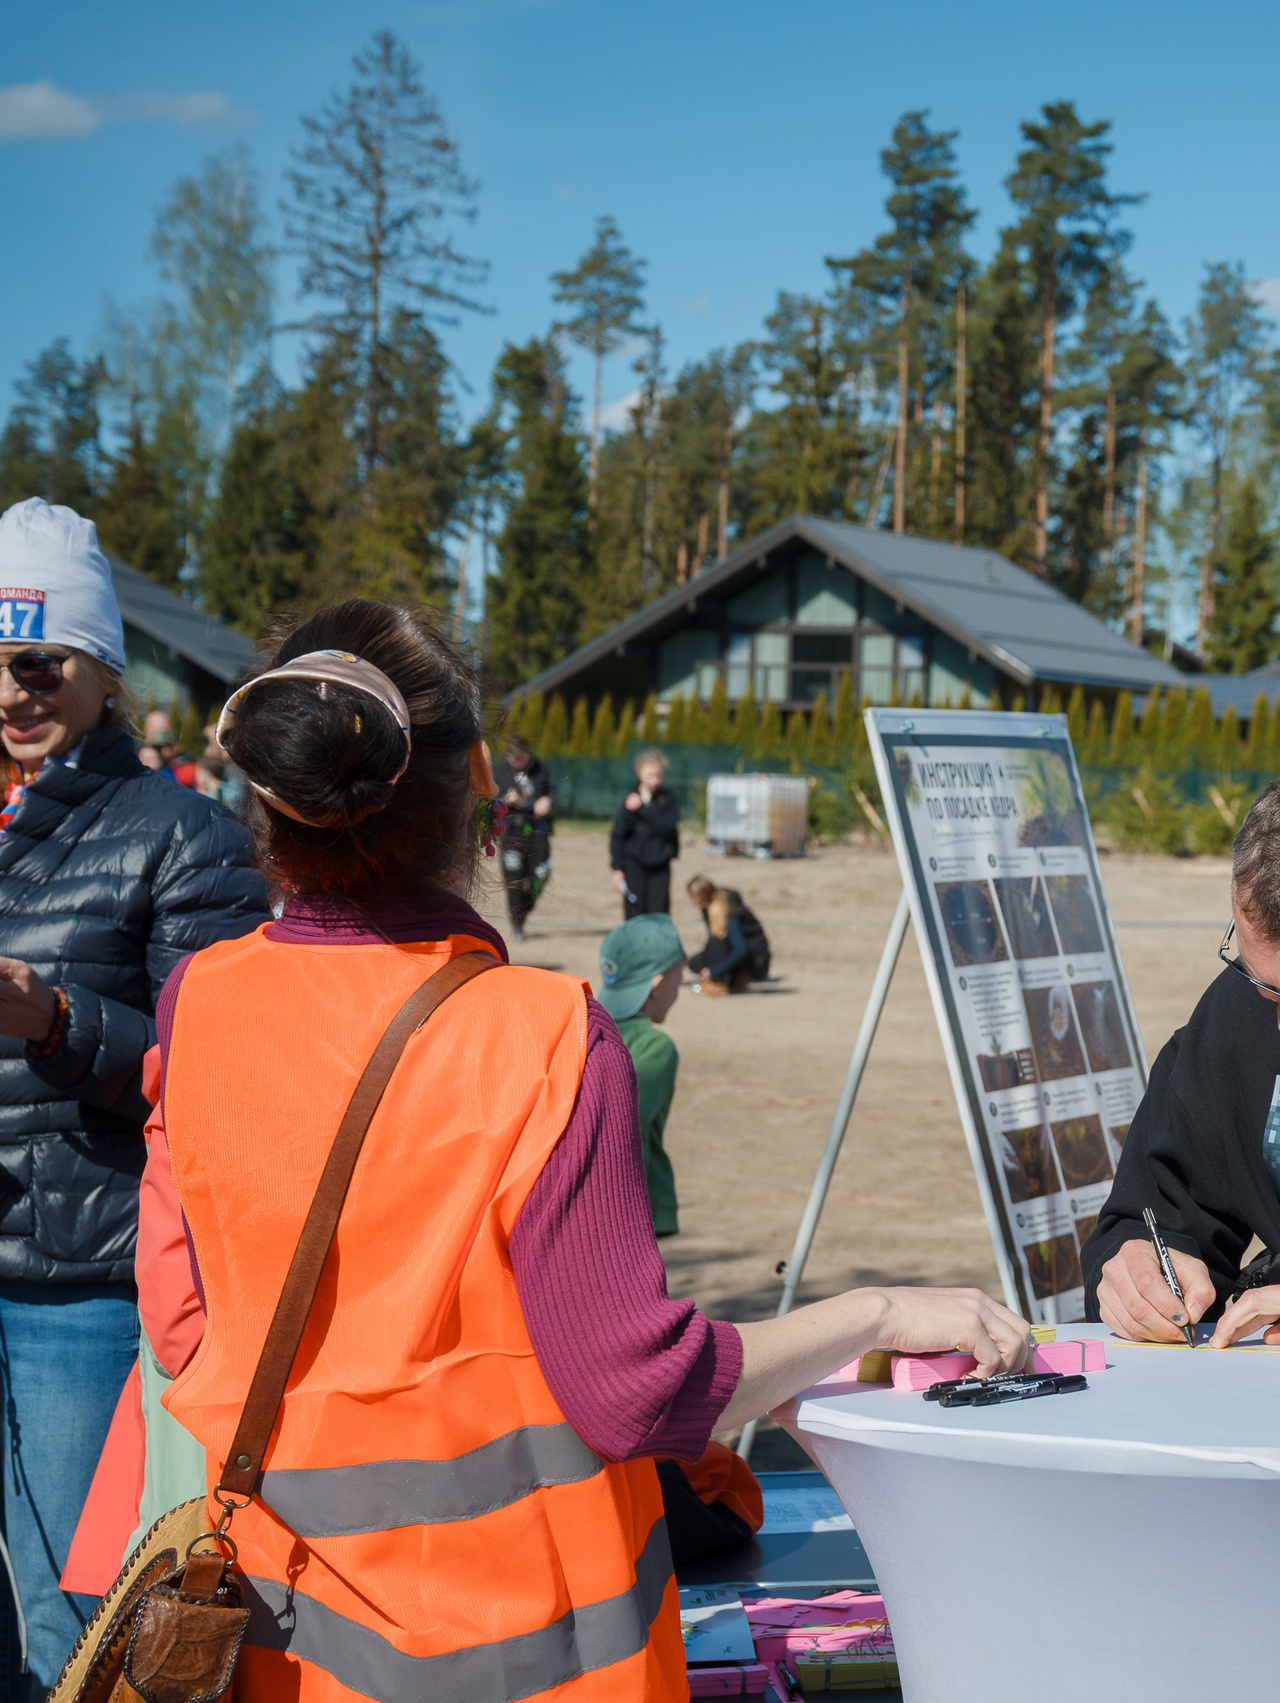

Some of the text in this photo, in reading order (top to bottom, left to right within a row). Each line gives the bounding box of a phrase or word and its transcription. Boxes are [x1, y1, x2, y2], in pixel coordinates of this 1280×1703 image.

[0, 588, 43, 601] ОМАНДА
[0, 602, 38, 637] 47
[917, 762, 995, 789] ИНСТРУКЦИЯ
[927, 797, 943, 819] ПО
[944, 797, 990, 820] ПОСАДКЕ
